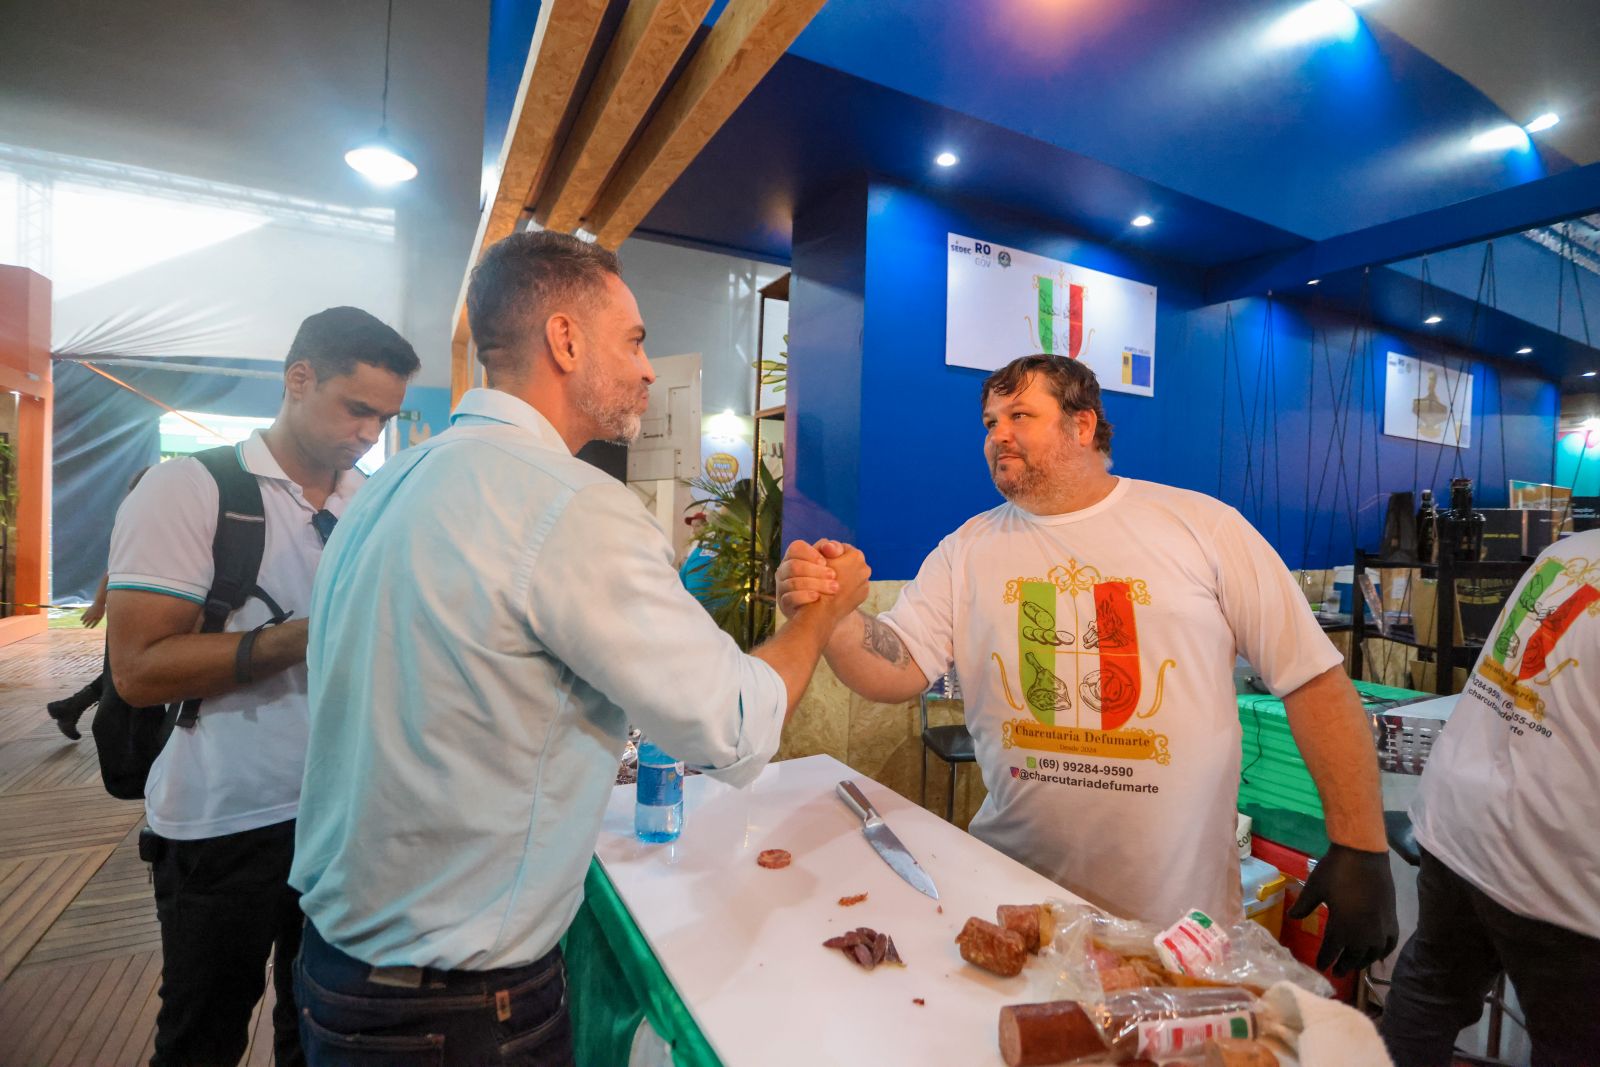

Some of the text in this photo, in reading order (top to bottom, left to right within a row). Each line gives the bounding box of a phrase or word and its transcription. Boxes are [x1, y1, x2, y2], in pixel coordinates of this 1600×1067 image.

[951, 245, 972, 254] SEDEC
[975, 242, 991, 255] RO
[1015, 725, 1150, 747] Charcutaria Defumarte
[1039, 758, 1134, 777] (69) 99284-9590
[1020, 768, 1159, 794] @charcutariadefumarte
